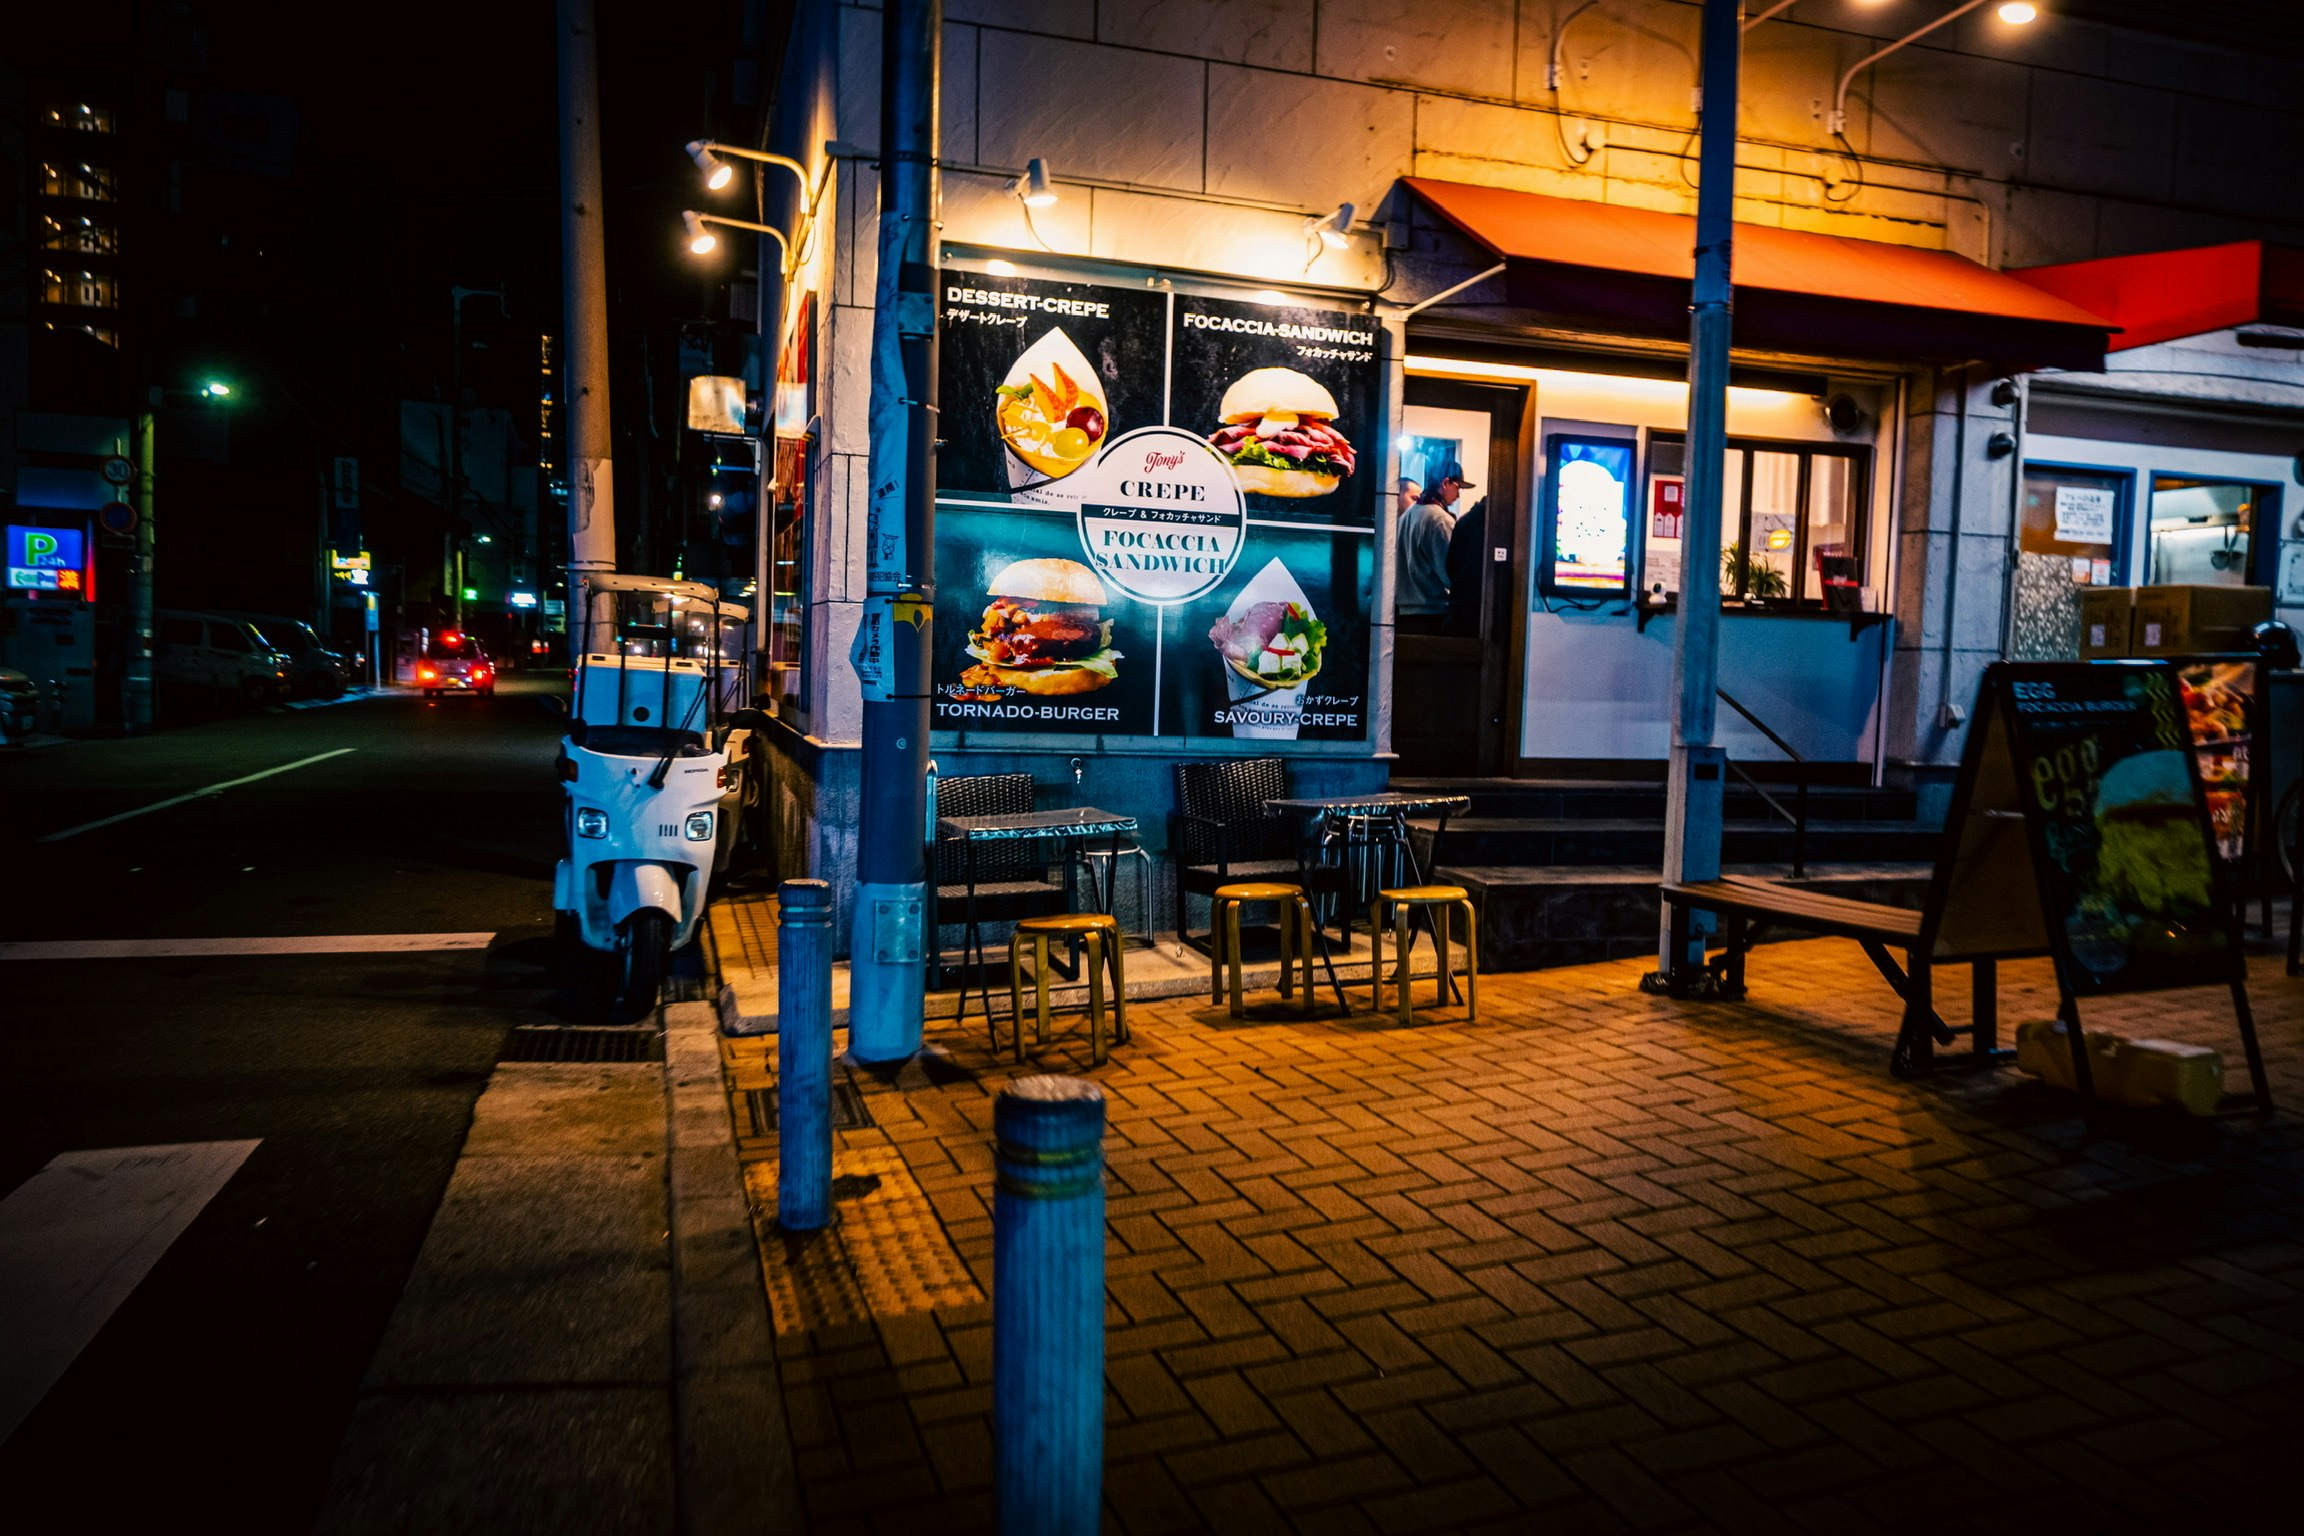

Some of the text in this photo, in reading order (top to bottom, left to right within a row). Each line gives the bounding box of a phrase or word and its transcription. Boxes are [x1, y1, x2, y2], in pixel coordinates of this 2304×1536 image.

[947, 286, 1109, 319] DESSERT-CREPE
[946, 308, 1028, 329] デザートクレープ
[1183, 313, 1374, 346] FOCACCIA-SANDWICH
[1296, 345, 1373, 362] フォカッチャサンド
[1144, 450, 1185, 474] Tony's
[1120, 480, 1205, 501] CREPE
[1103, 508, 1137, 518] クレープ
[1151, 511, 1221, 523] フォカッチャサンド
[24, 532, 58, 566] P
[1103, 530, 1220, 552] FOCACCIA
[1095, 553, 1226, 574] SANDWICH
[937, 683, 1026, 697] トルネードバーガー
[1296, 694, 1359, 706] おかずクレープ
[2012, 681, 2056, 699] EGG
[936, 703, 1119, 721] TORNADO-BURGER
[1214, 710, 1357, 727] SAVOURY-CREPE
